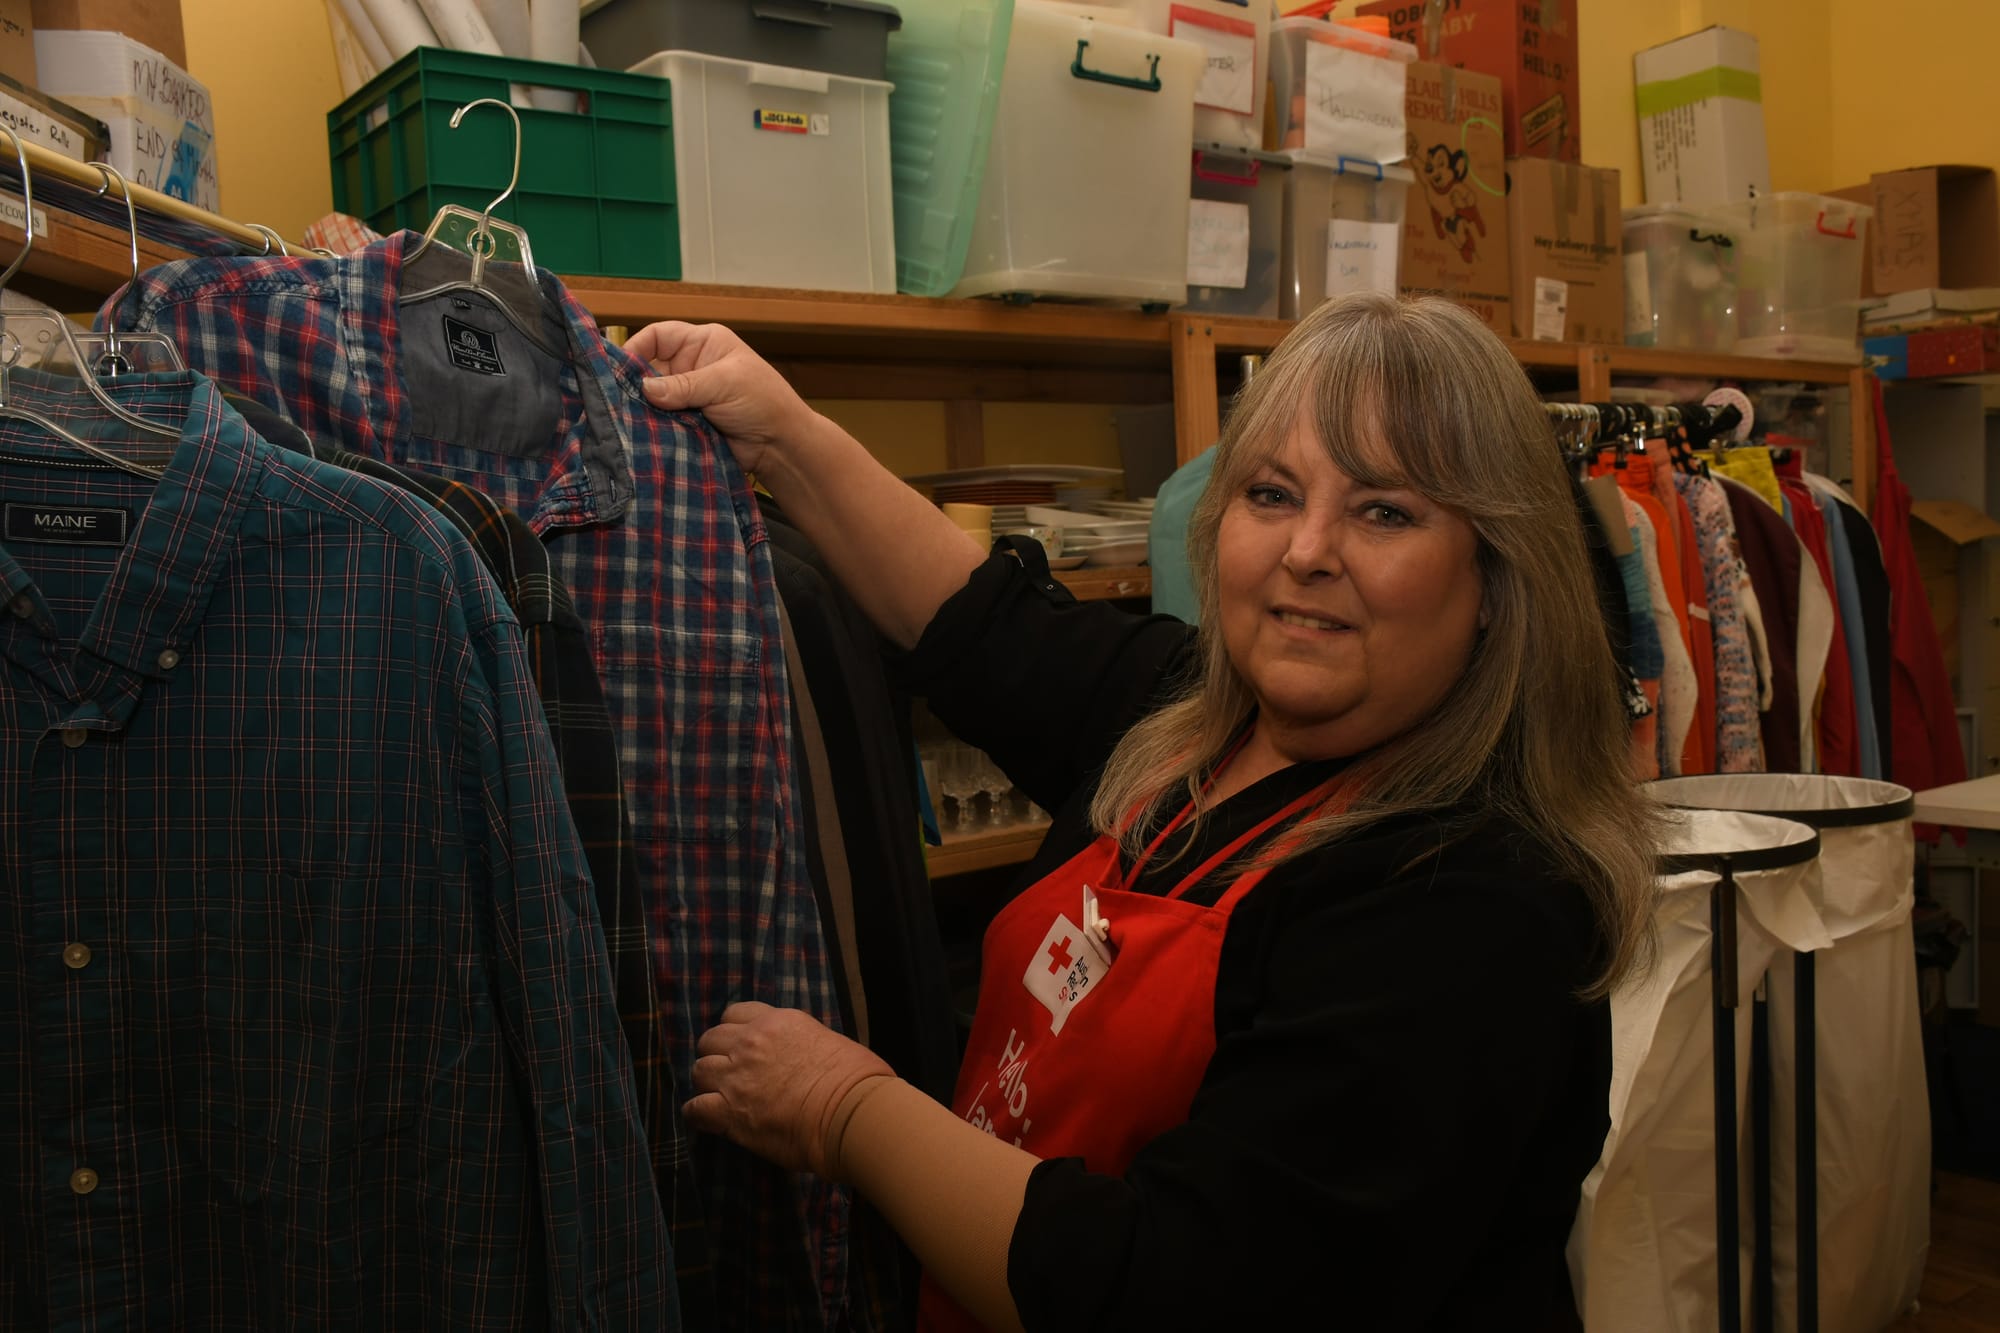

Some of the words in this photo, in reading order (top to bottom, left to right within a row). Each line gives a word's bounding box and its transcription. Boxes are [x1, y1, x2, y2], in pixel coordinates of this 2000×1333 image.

[1523, 29, 1540, 49] AT
[134, 60, 159, 103] MY
[160, 66, 208, 124] BANKER
[1459, 87, 1499, 114] HILLS
[0, 111, 41, 135] egister
[34, 513, 97, 528] MAINE
